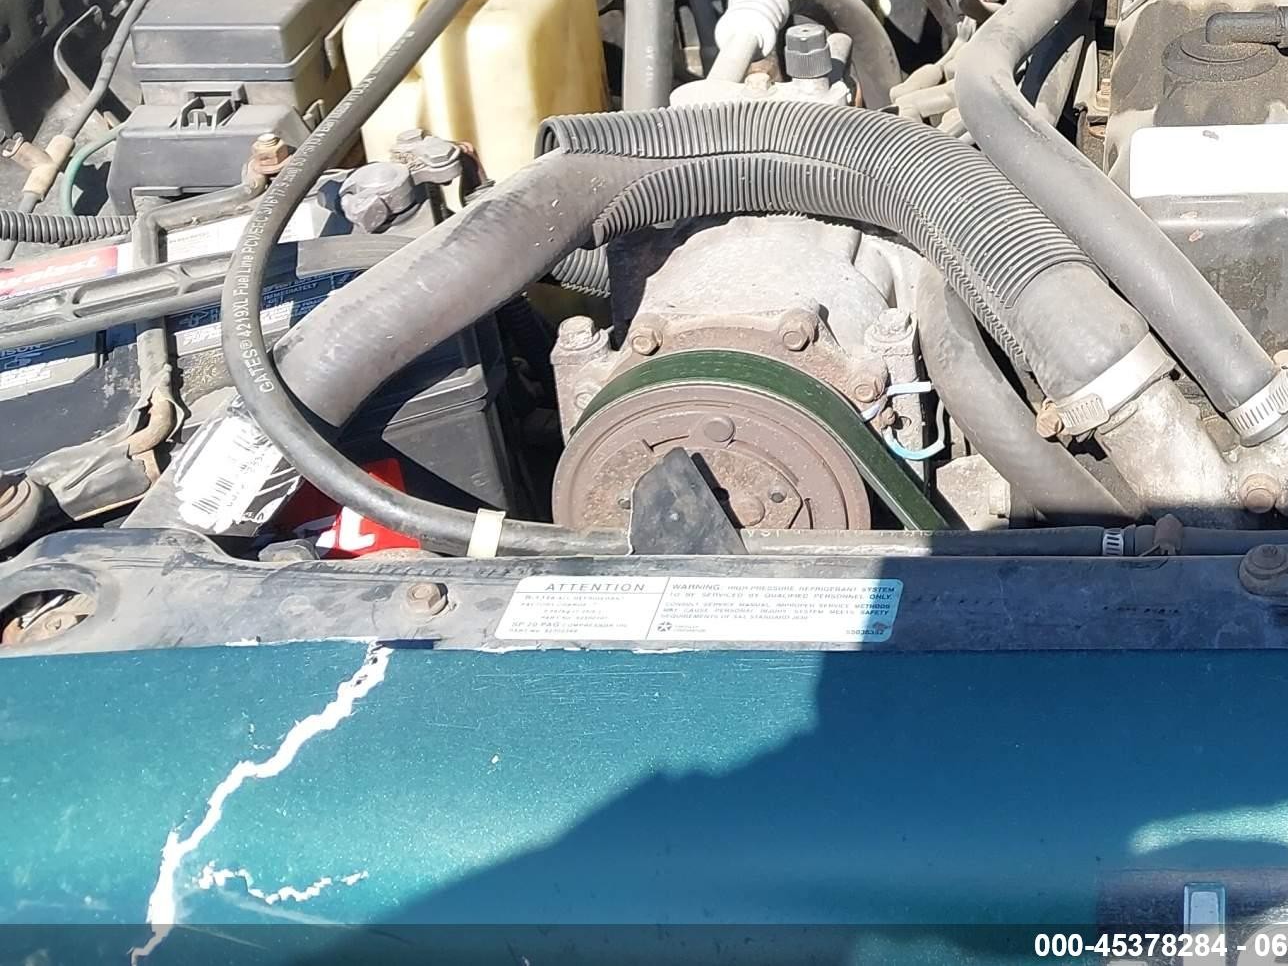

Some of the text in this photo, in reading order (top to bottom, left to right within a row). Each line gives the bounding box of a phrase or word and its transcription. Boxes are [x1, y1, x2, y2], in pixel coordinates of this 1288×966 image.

[240, 255, 255, 276] Line
[233, 275, 250, 297] Fuel
[232, 296, 252, 338] 4219XL
[544, 583, 646, 592] ATTENTION
